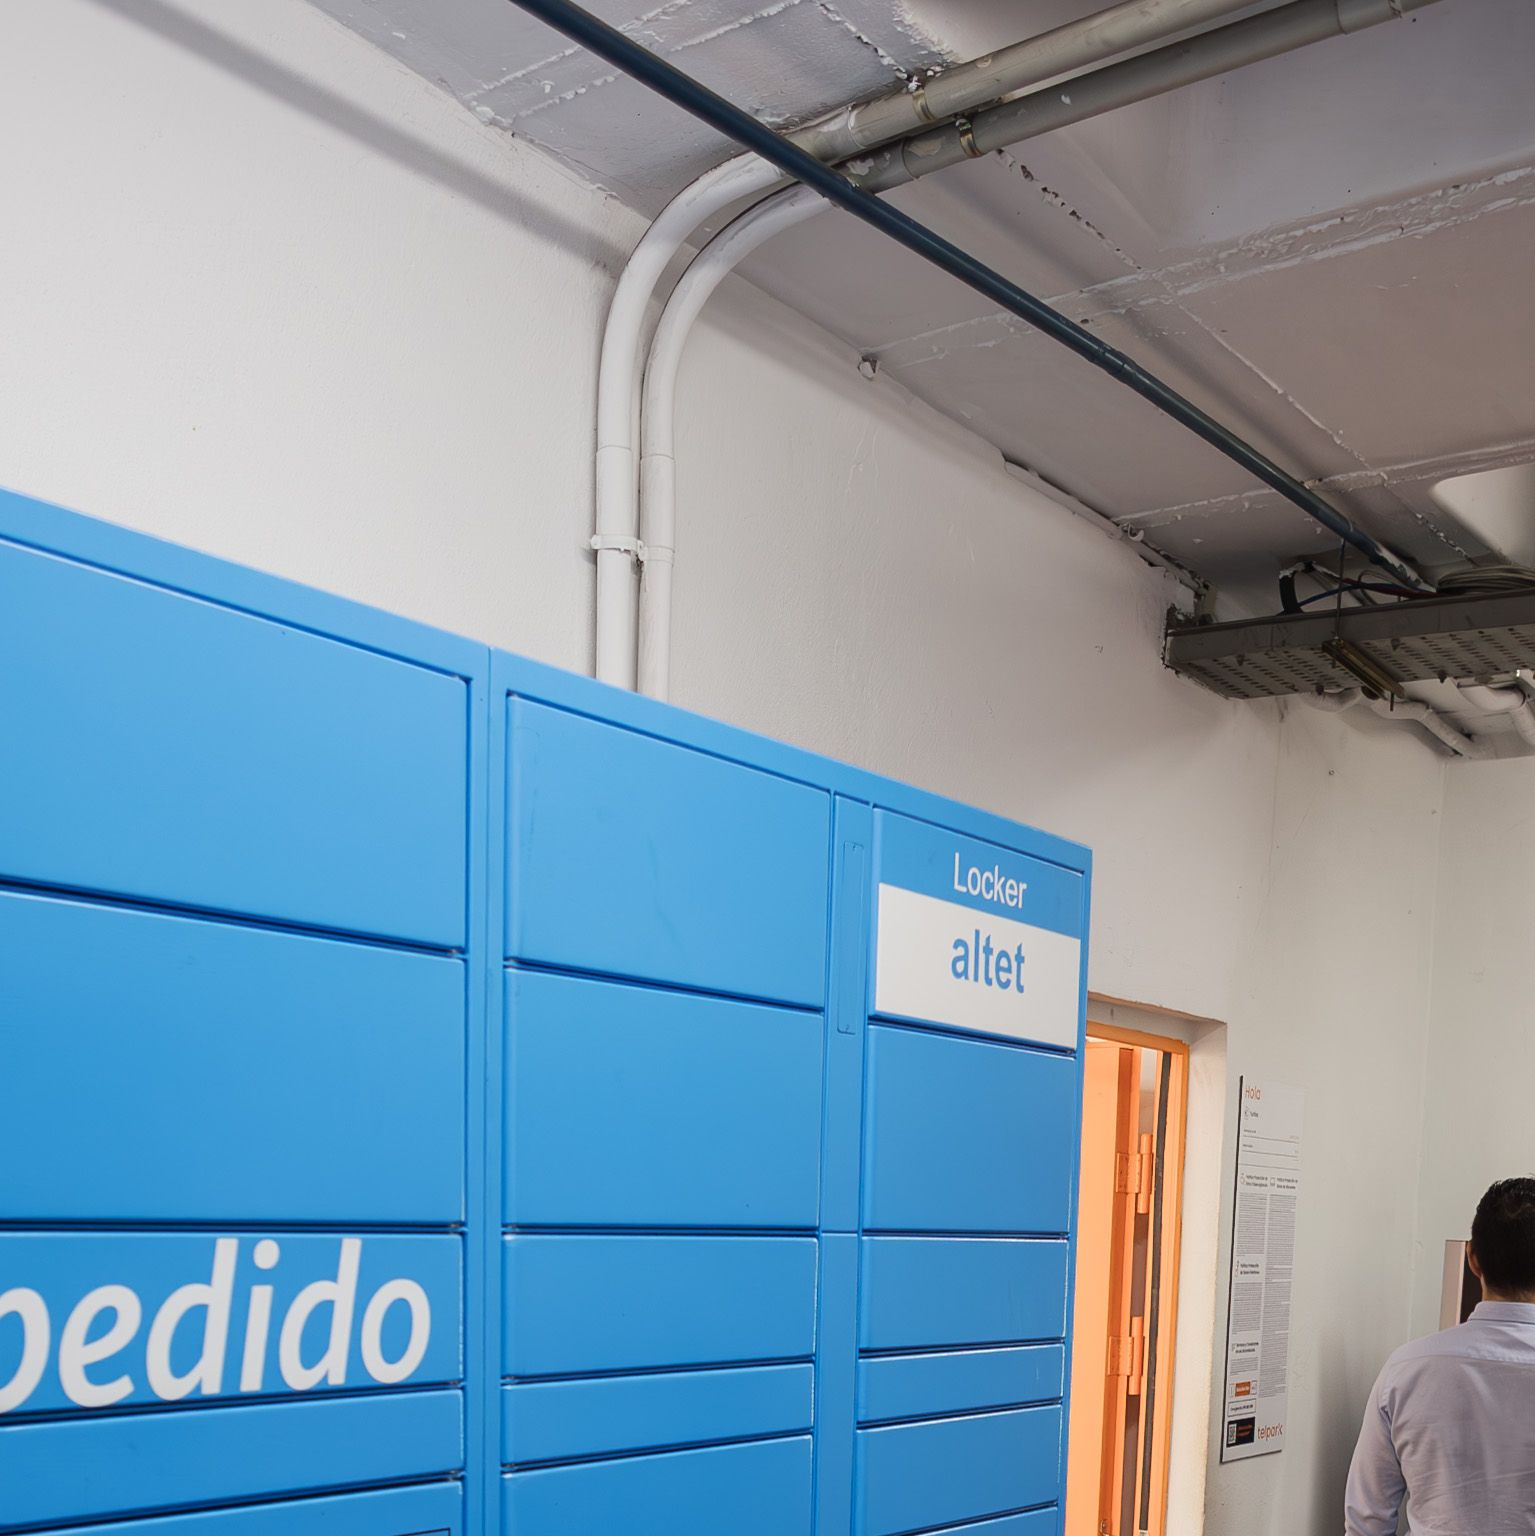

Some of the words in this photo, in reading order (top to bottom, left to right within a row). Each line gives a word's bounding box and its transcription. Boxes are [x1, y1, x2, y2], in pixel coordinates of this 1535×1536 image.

[954, 852, 1028, 909] Locker
[951, 929, 1025, 994] altet
[1257, 1423, 1283, 1441] telpark
